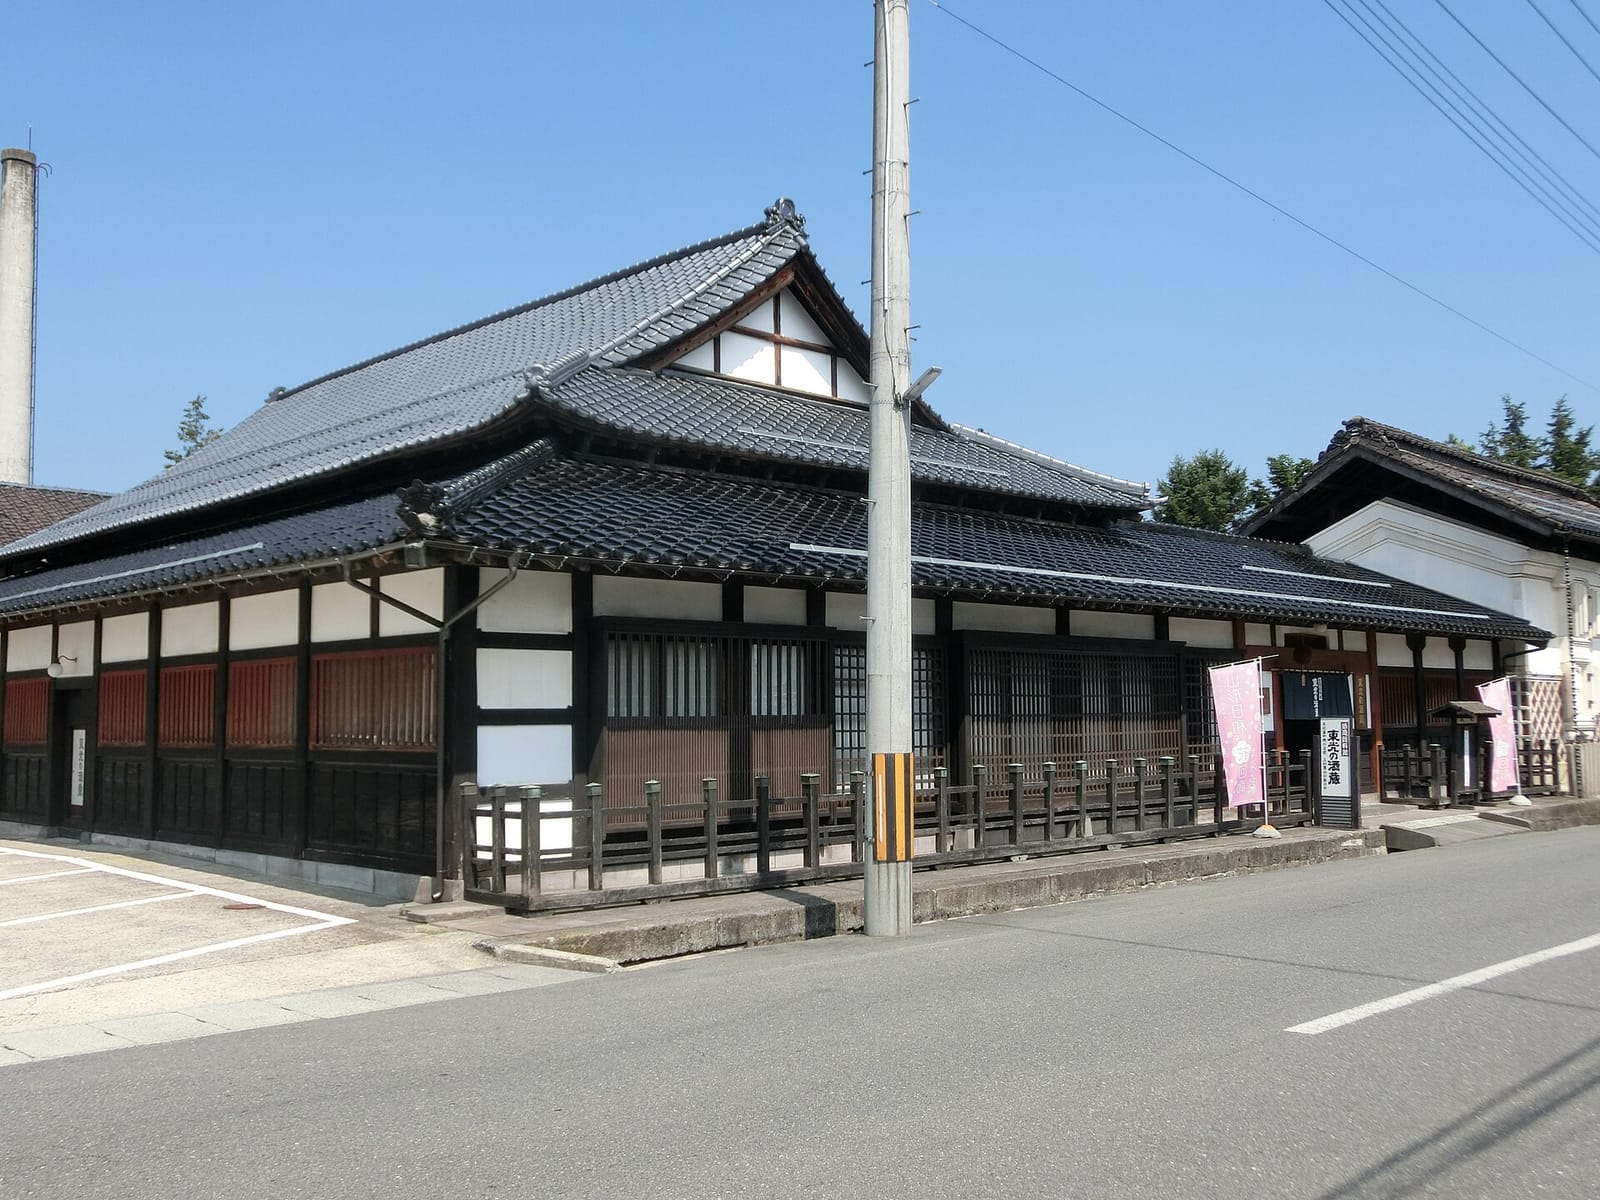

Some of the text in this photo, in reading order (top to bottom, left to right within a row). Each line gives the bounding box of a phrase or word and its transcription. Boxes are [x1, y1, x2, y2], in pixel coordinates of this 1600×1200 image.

[1327, 729, 1340, 785] 東光の酒蔵
